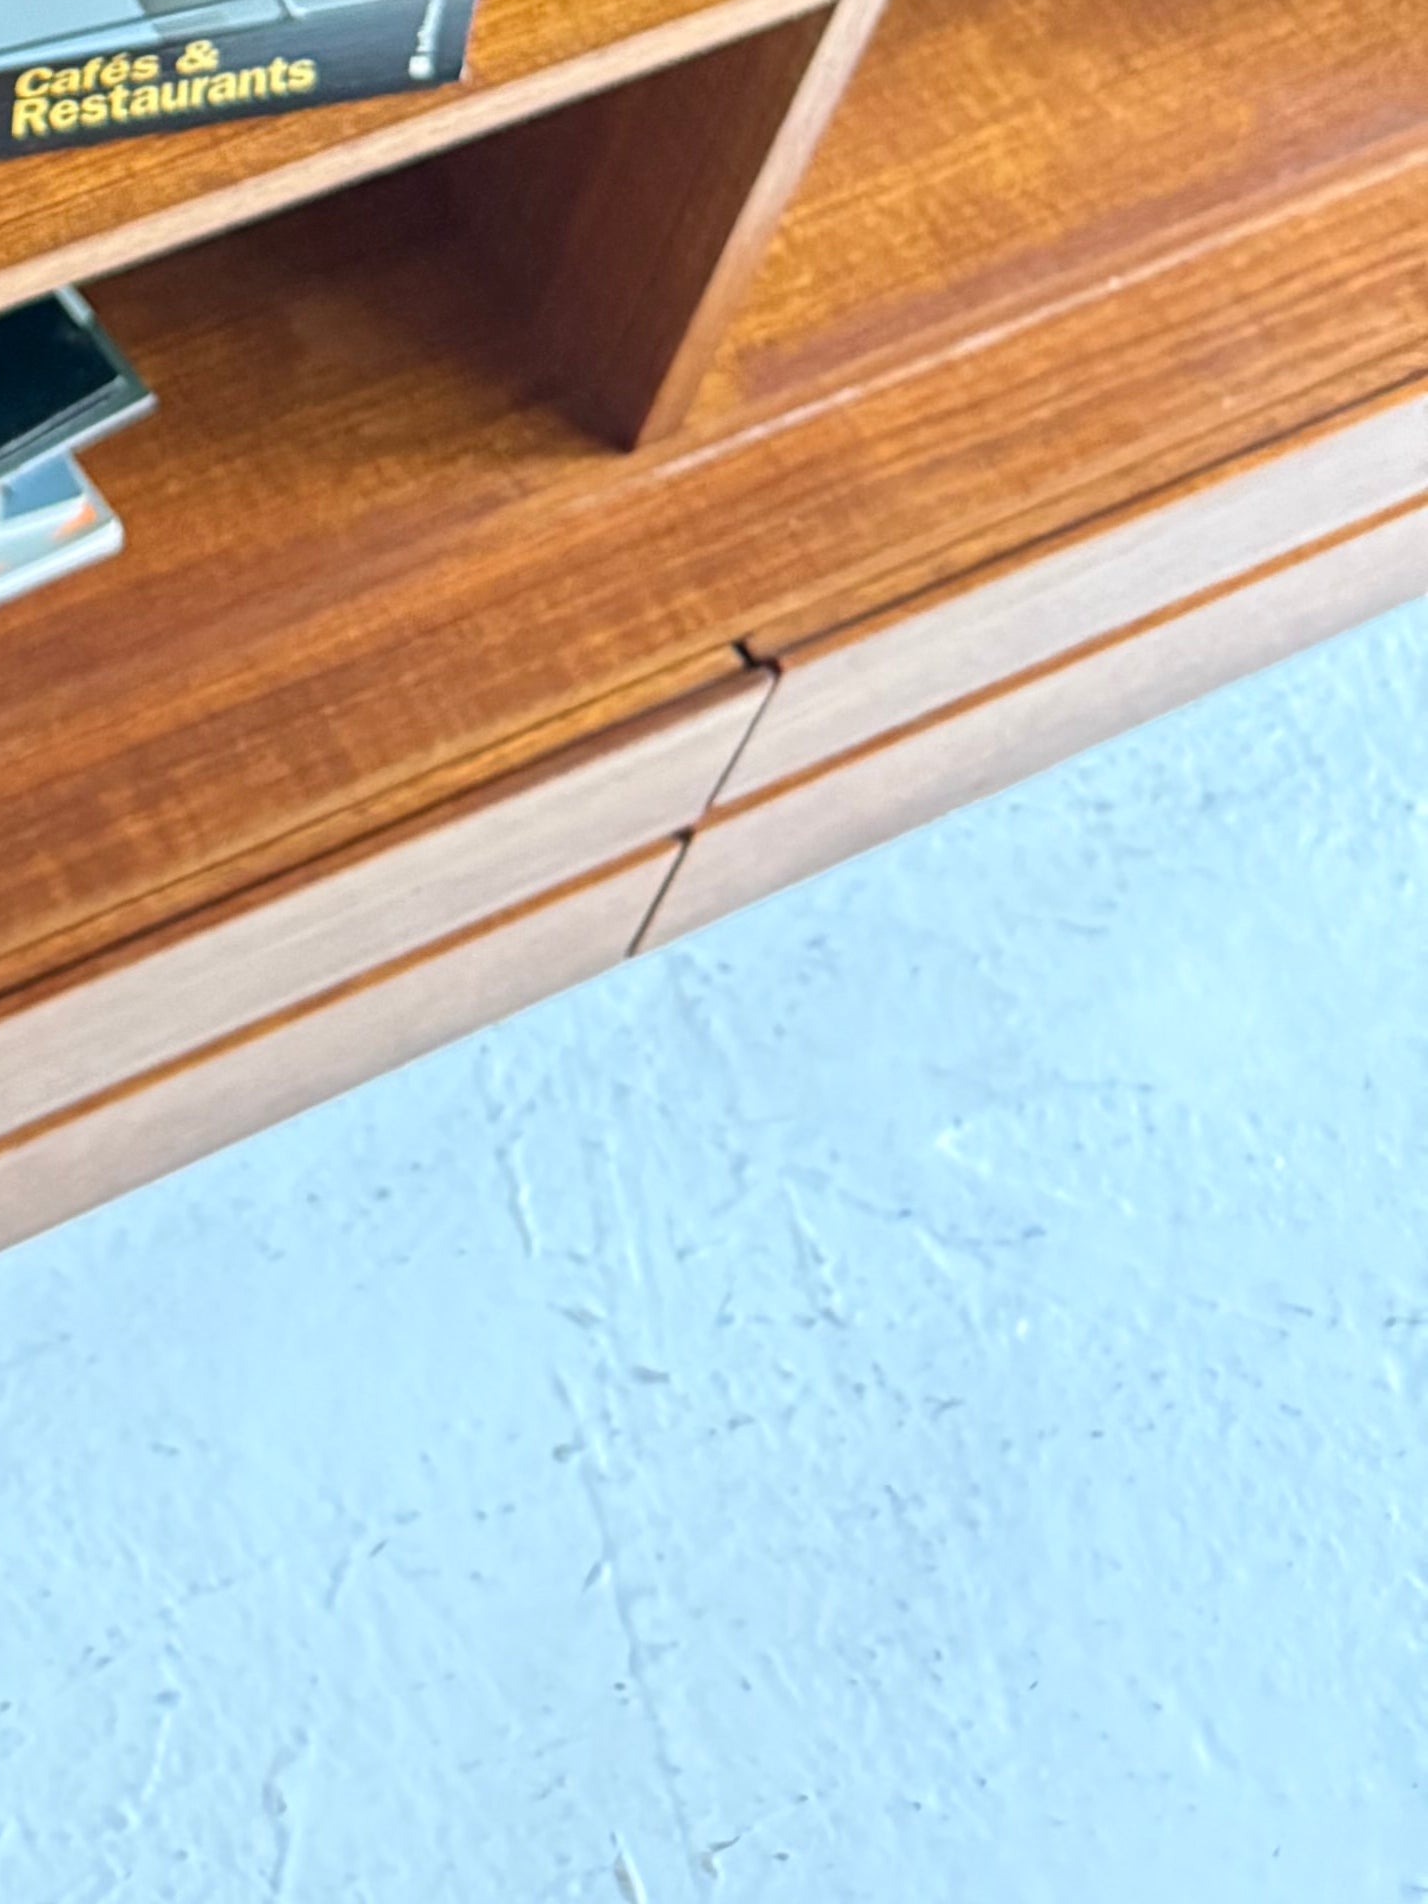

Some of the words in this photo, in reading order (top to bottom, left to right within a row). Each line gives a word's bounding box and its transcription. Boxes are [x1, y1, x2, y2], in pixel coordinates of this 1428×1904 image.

[10, 55, 318, 139] Restaurants
[13, 50, 160, 98] Cafés
[175, 38, 220, 74] &
